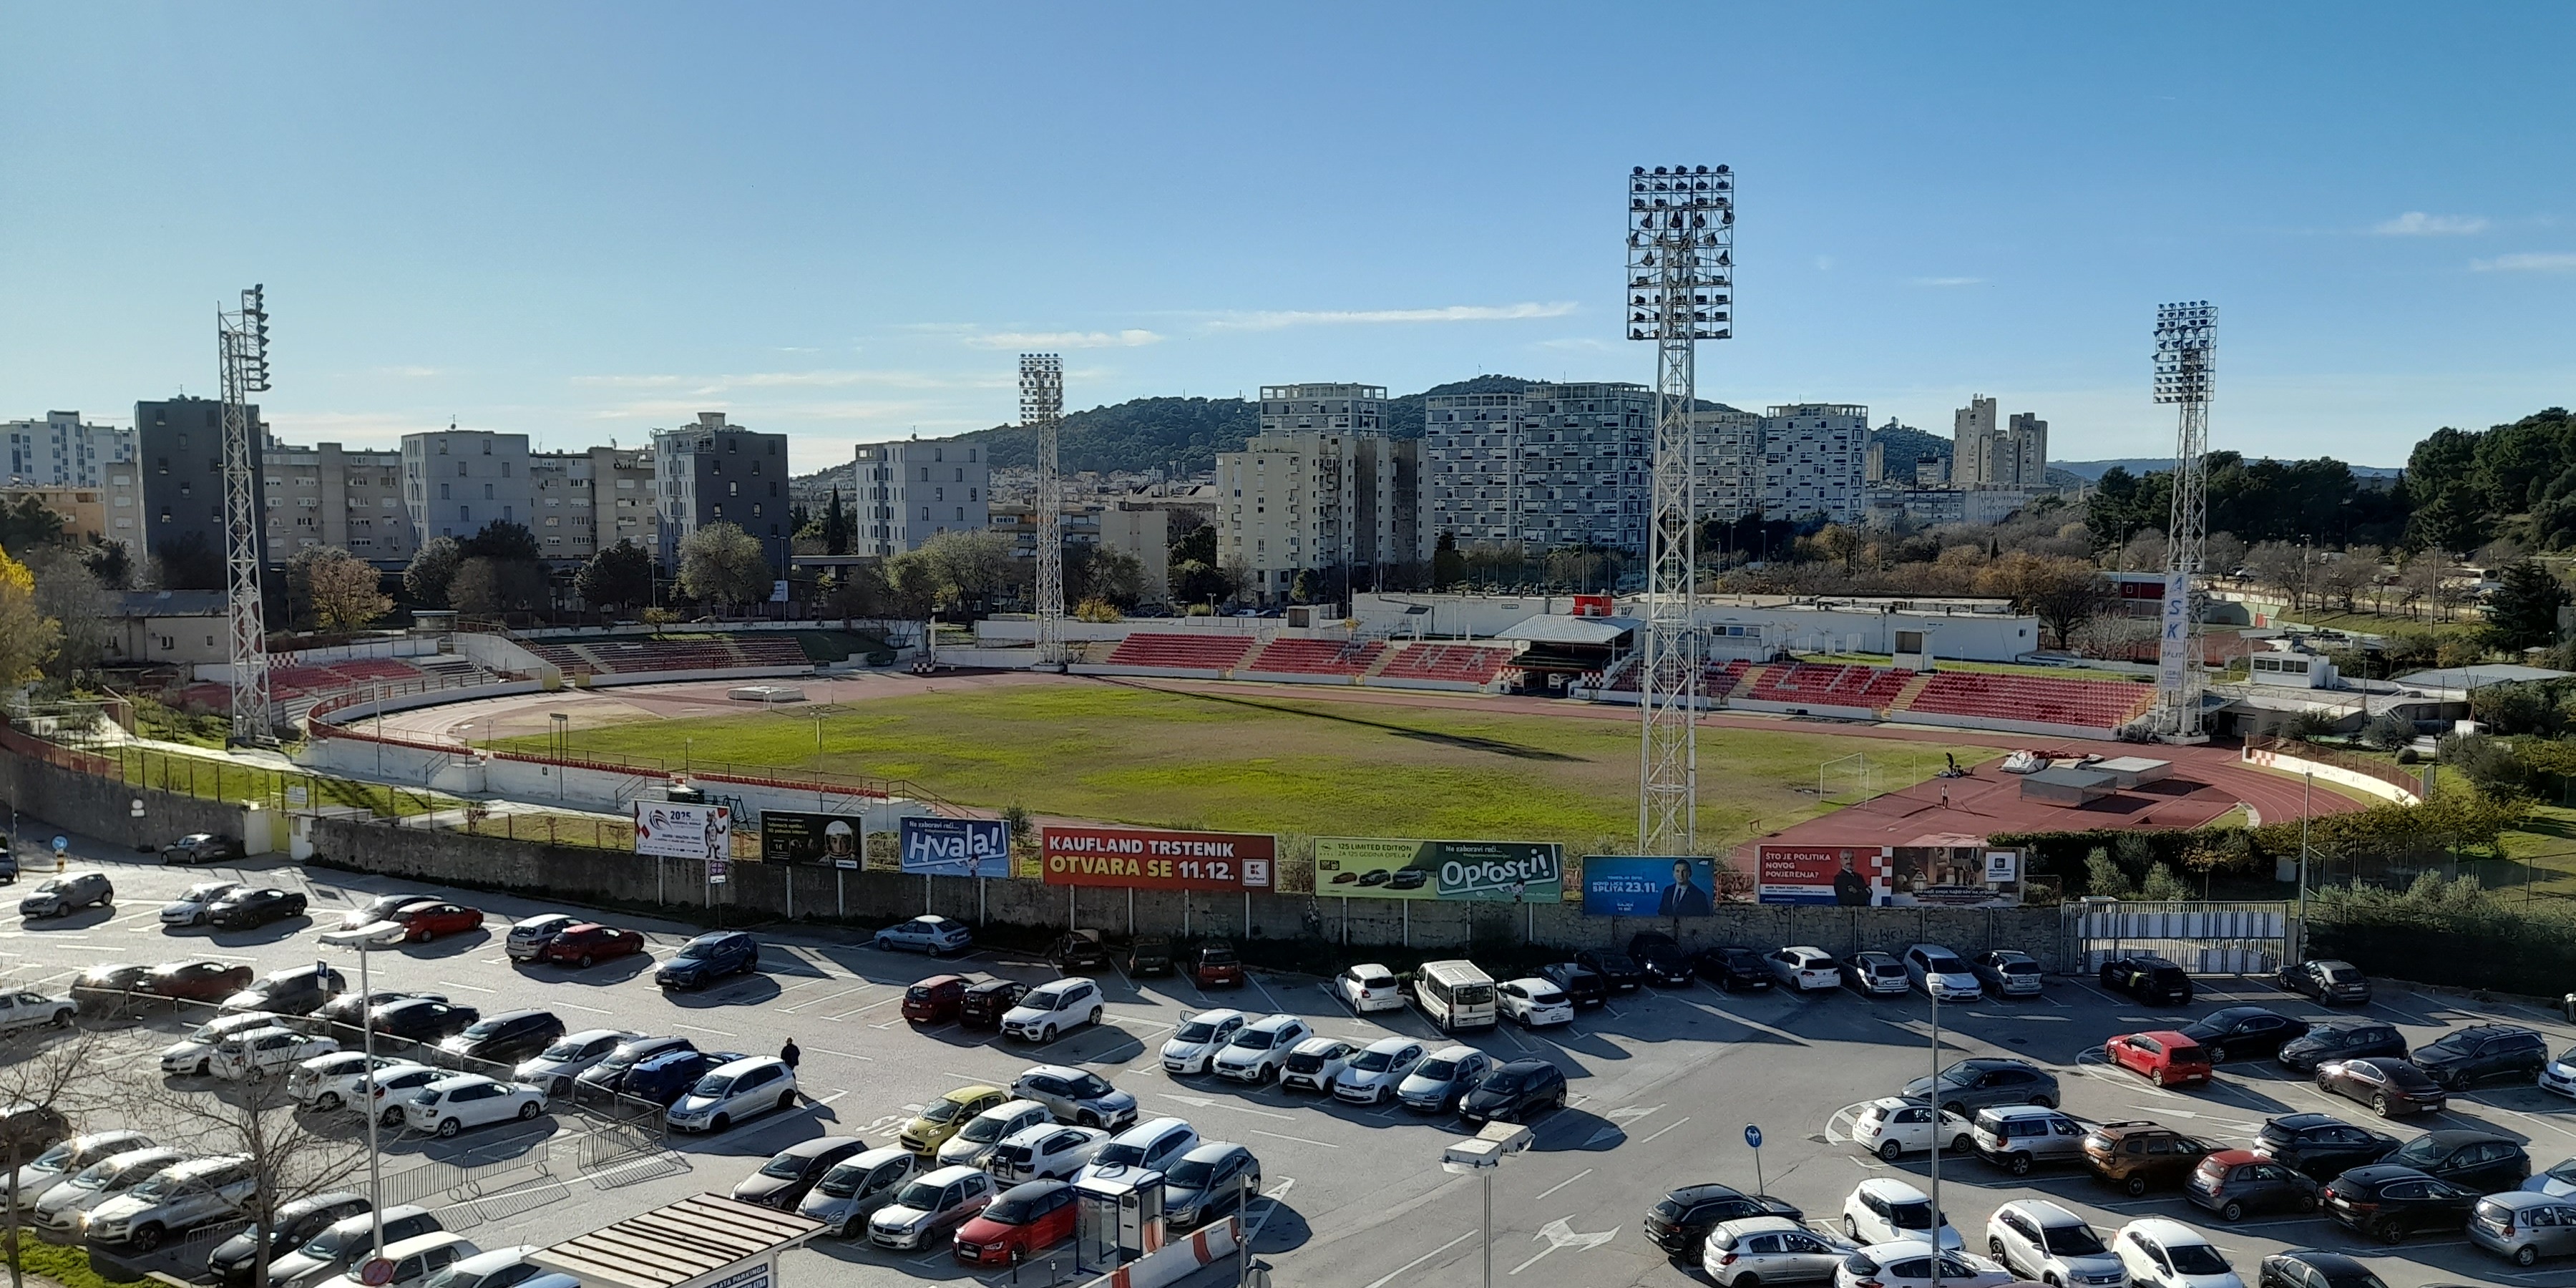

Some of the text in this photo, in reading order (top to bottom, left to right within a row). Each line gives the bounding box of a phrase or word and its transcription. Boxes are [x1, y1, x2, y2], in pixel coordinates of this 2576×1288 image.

[670, 810, 691, 821] 2025
[908, 824, 1000, 863] Hvala!
[1049, 835, 1235, 858] KAUFLAND TRSTENIK
[1765, 852, 1782, 860] ŠTO
[1049, 855, 1236, 881] OTVARA SE 11.12.
[1441, 848, 1551, 888] Oprosti!
[1625, 882, 1659, 893] 23.11.
[733, 1264, 766, 1284] PARKINGA
